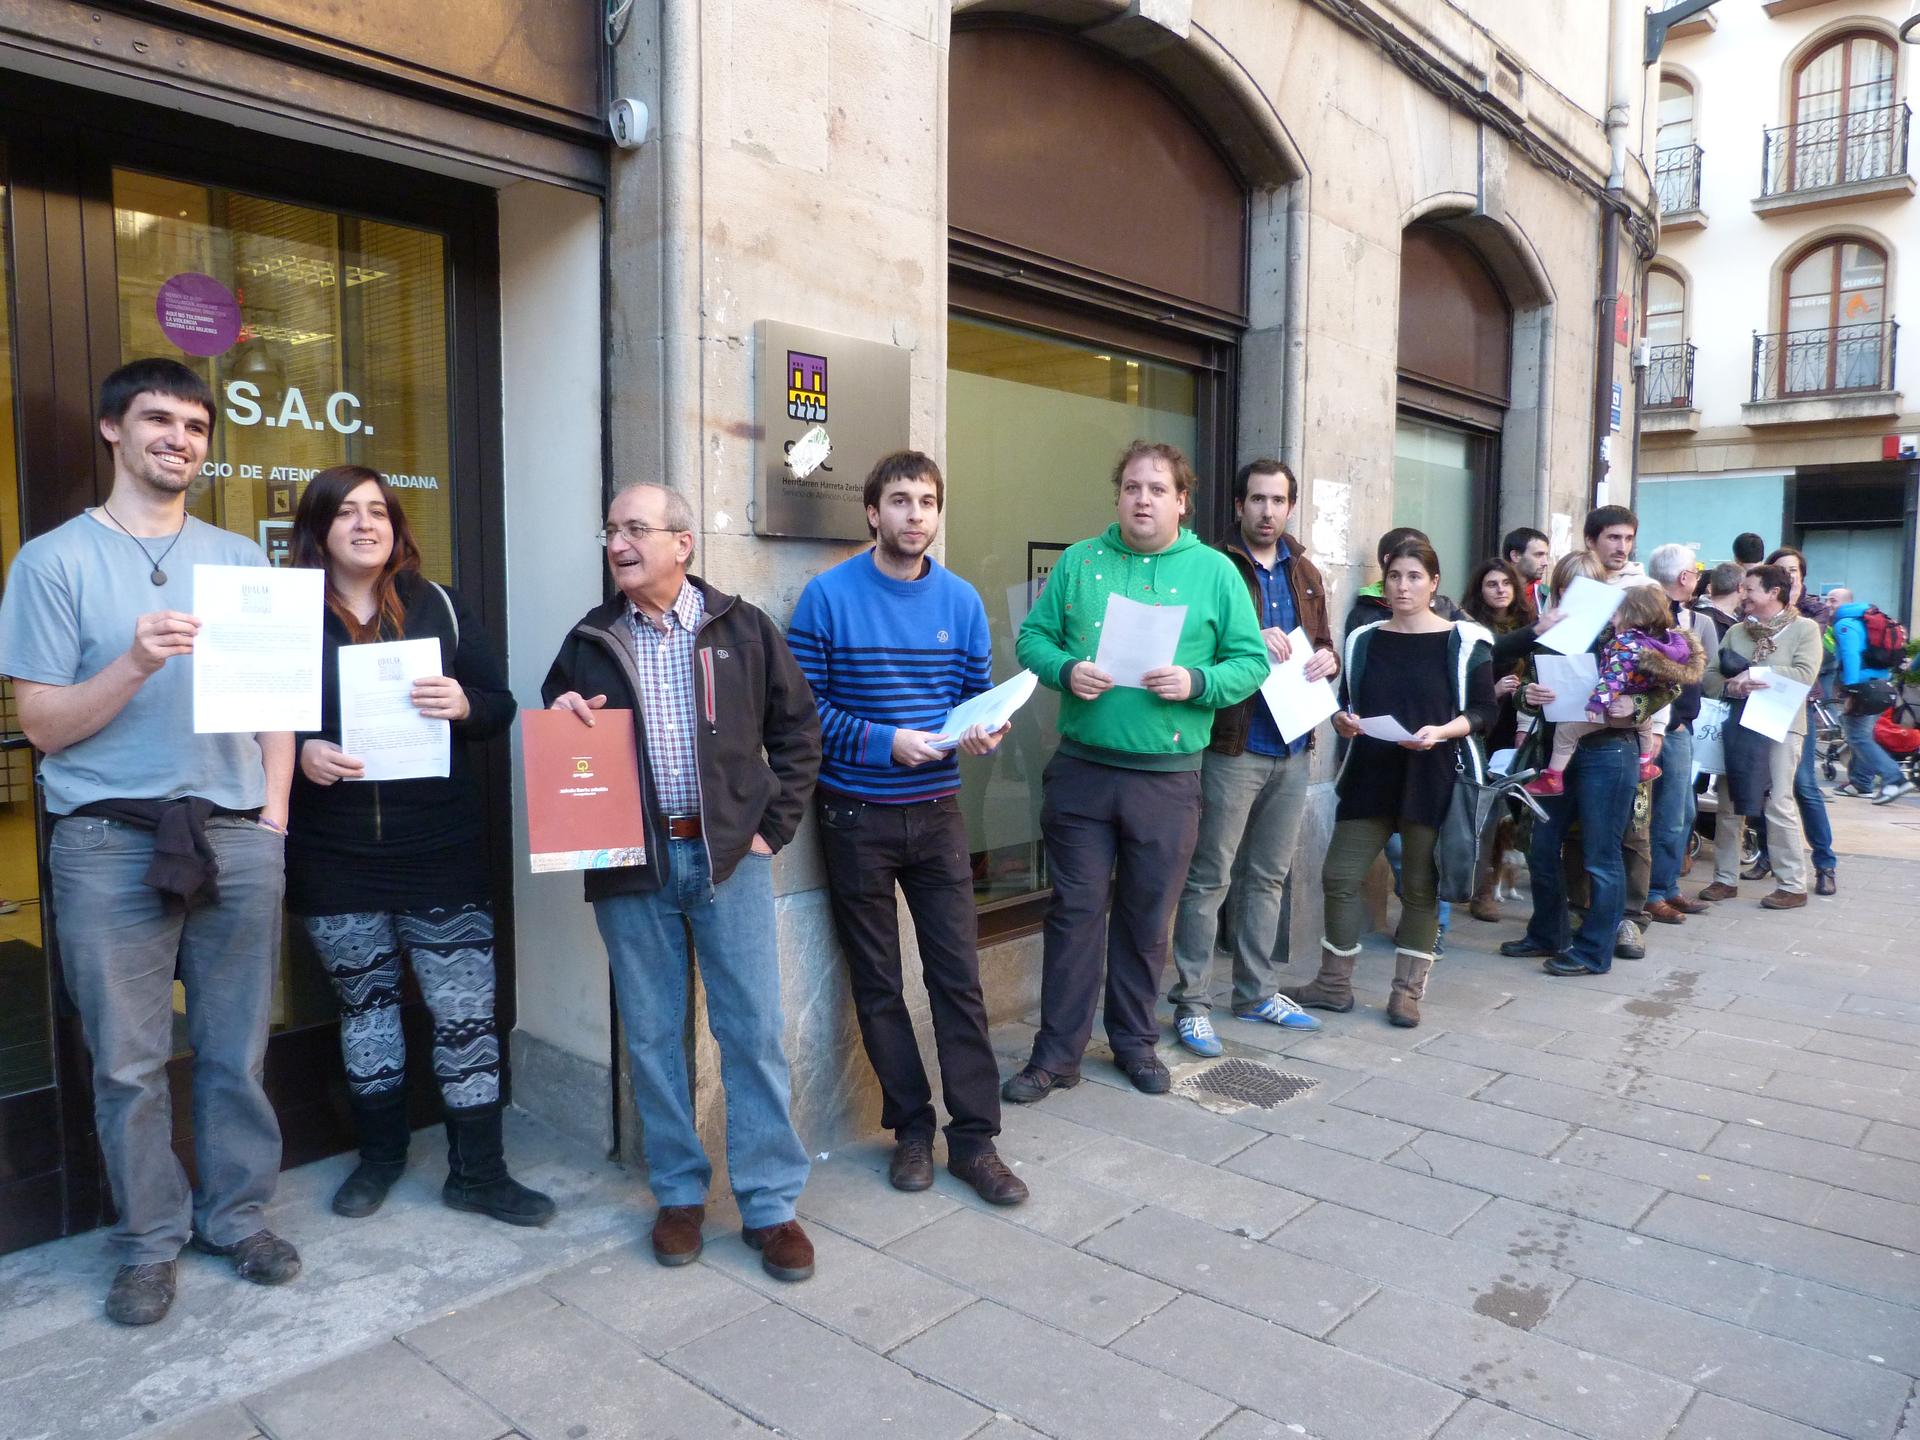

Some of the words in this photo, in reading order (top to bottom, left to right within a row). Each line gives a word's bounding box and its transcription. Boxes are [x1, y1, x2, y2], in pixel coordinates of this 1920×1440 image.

[226, 380, 374, 435] S.A.C.
[198, 462, 233, 478] CIO
[240, 464, 263, 479] DE
[820, 481, 845, 490] Harreta
[845, 483, 864, 492] Zerbit
